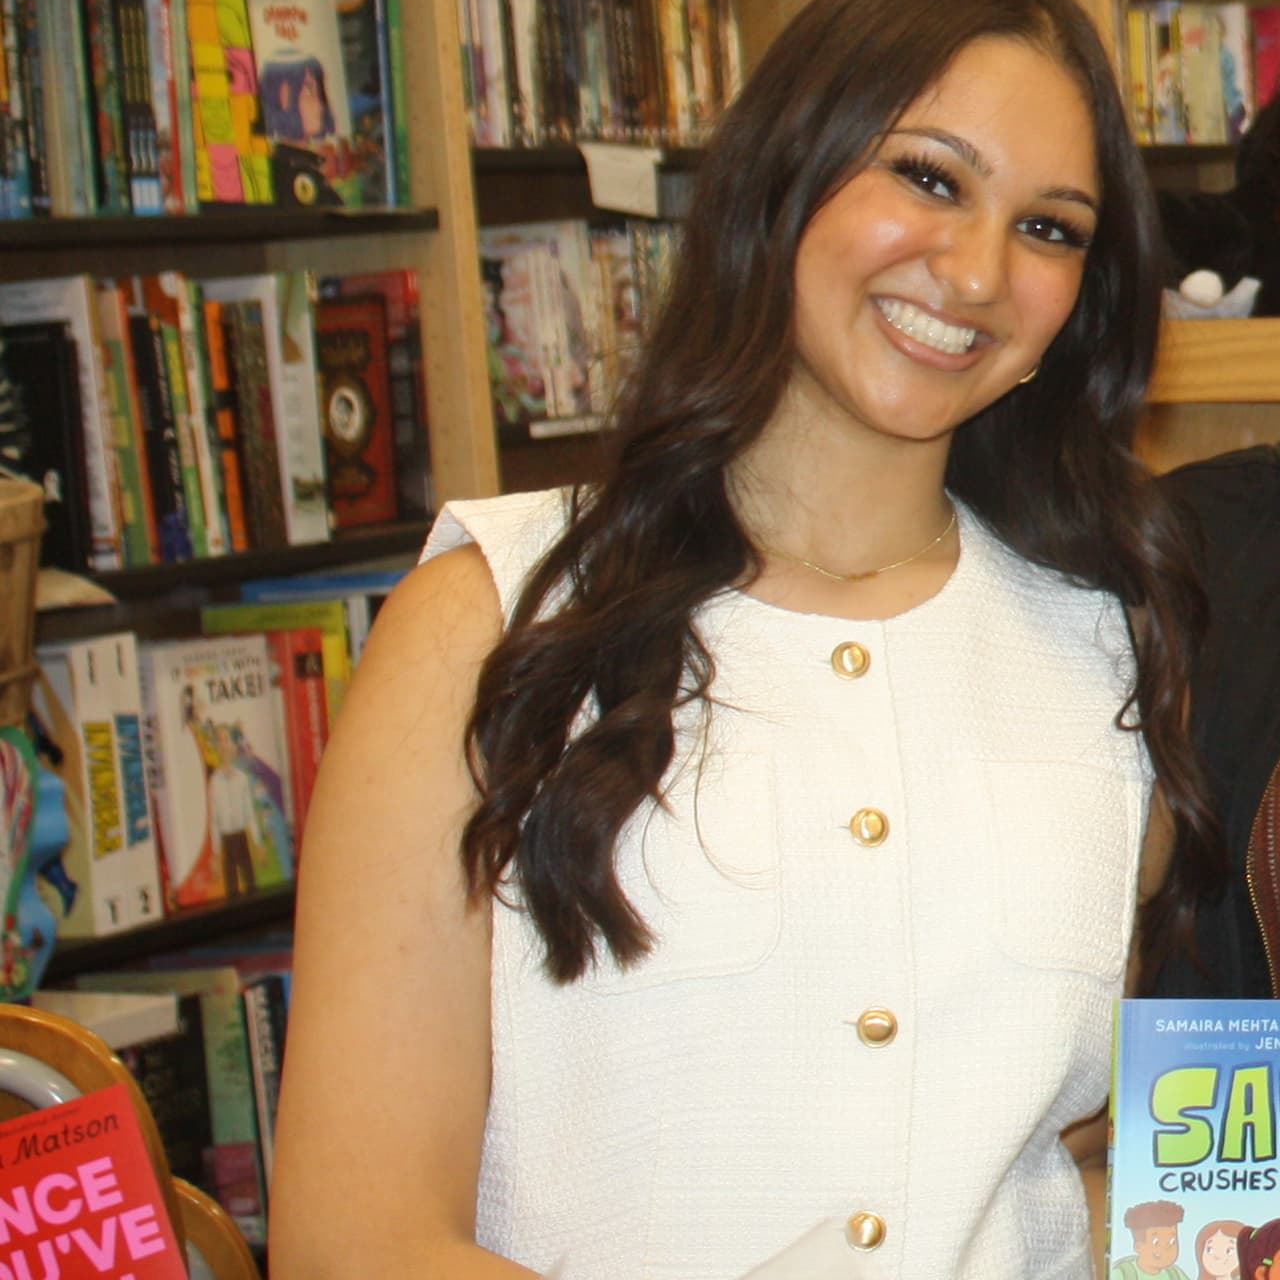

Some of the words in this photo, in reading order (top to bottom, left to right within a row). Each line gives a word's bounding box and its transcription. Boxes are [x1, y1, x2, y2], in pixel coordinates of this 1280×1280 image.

[206, 671, 264, 704] TAKEI
[1155, 1019, 1224, 1032] SAMAIRA
[1228, 1019, 1279, 1032] MEHTA
[12, 1113, 120, 1166] Matson
[0, 1156, 124, 1245] NCE
[1159, 1169, 1278, 1193] CRUSHES
[0, 1203, 167, 1280] U'VE
